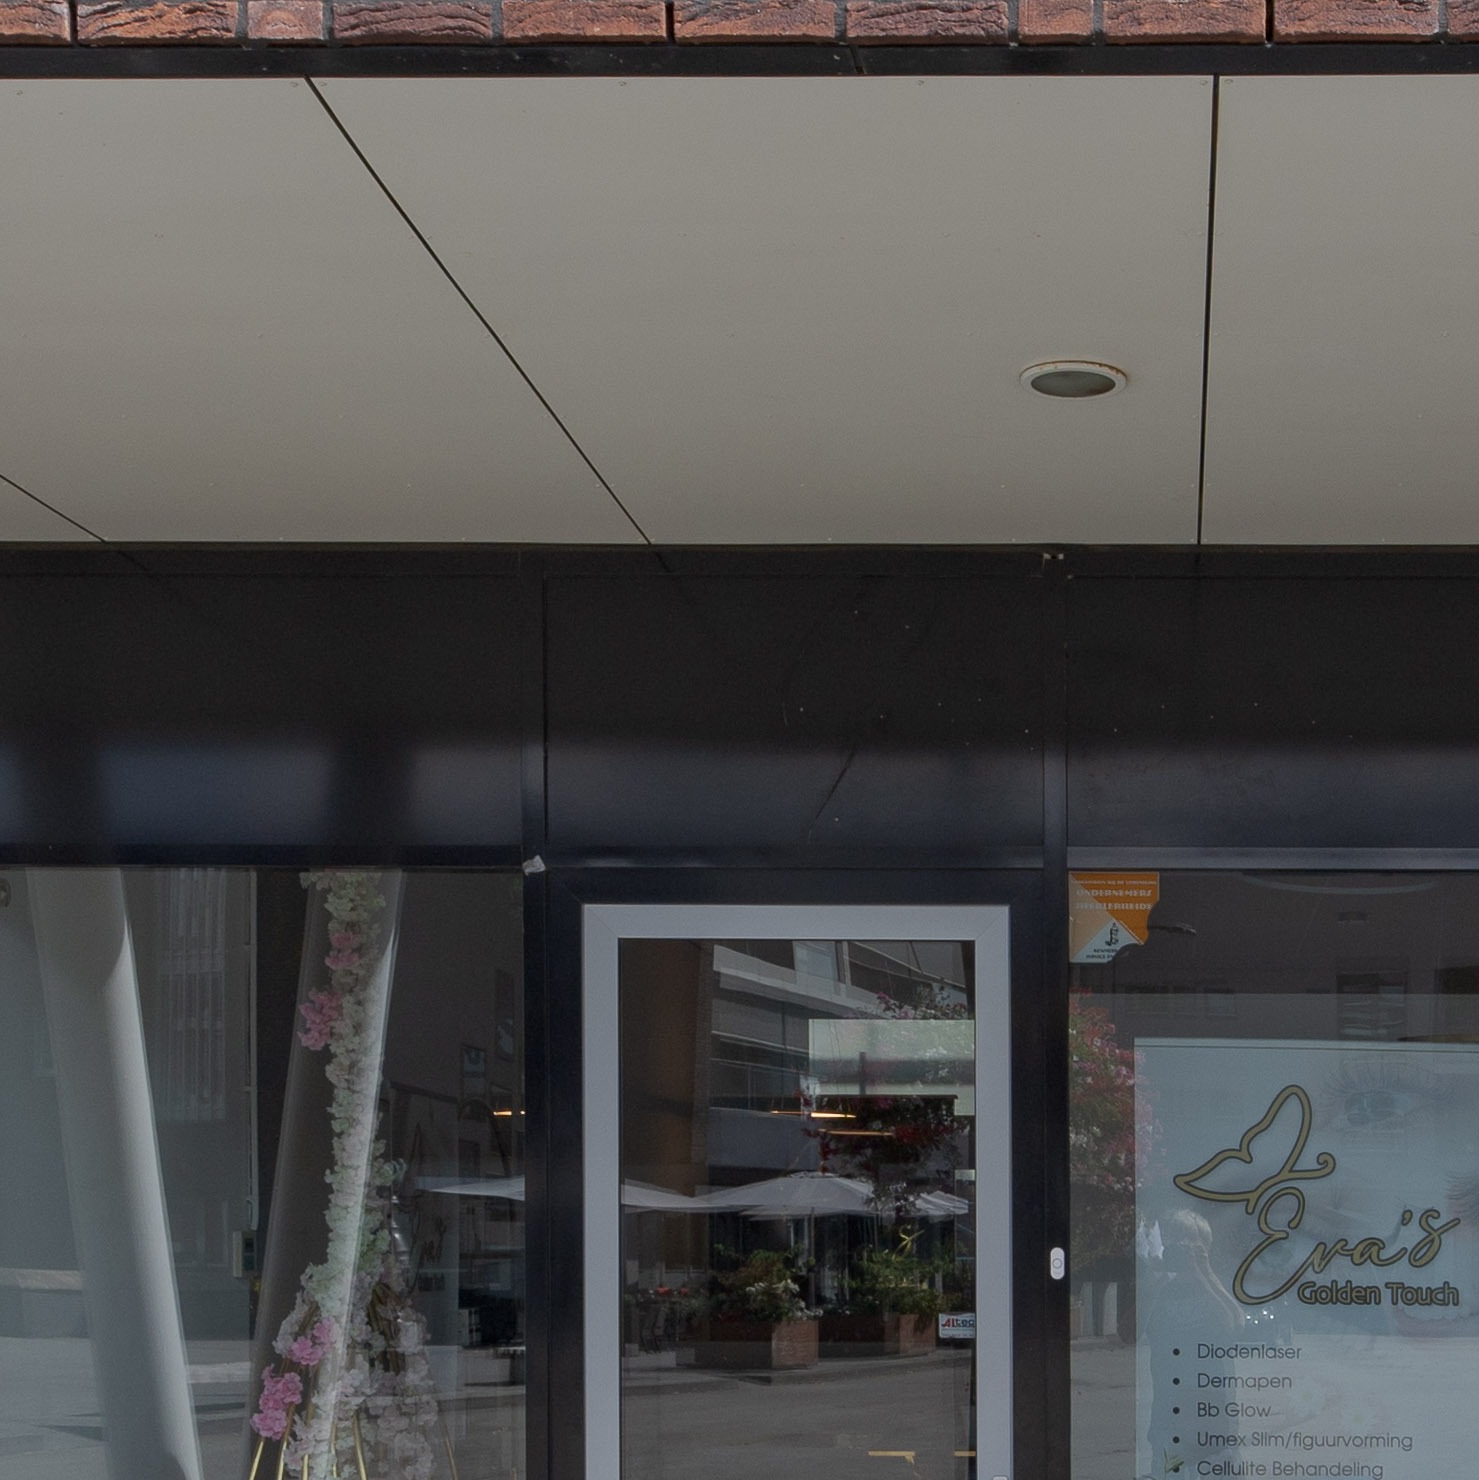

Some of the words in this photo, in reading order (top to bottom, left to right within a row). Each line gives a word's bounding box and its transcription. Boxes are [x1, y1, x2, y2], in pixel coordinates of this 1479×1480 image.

[1233, 1186, 1462, 1306] Eva's
[1297, 1280, 1382, 1306] Golden
[1385, 1281, 1460, 1307] Touch
[1197, 1343, 1303, 1360] Diodenlaser
[1197, 1373, 1293, 1391] Dermapen
[1197, 1402, 1220, 1418] Bb
[1224, 1402, 1272, 1418] Glow
[1197, 1432, 1246, 1447] Umex
[1251, 1431, 1413, 1452] Slim/figuurvorming
[1197, 1461, 1267, 1477] Cellulite
[1272, 1461, 1384, 1480] Behandeling
